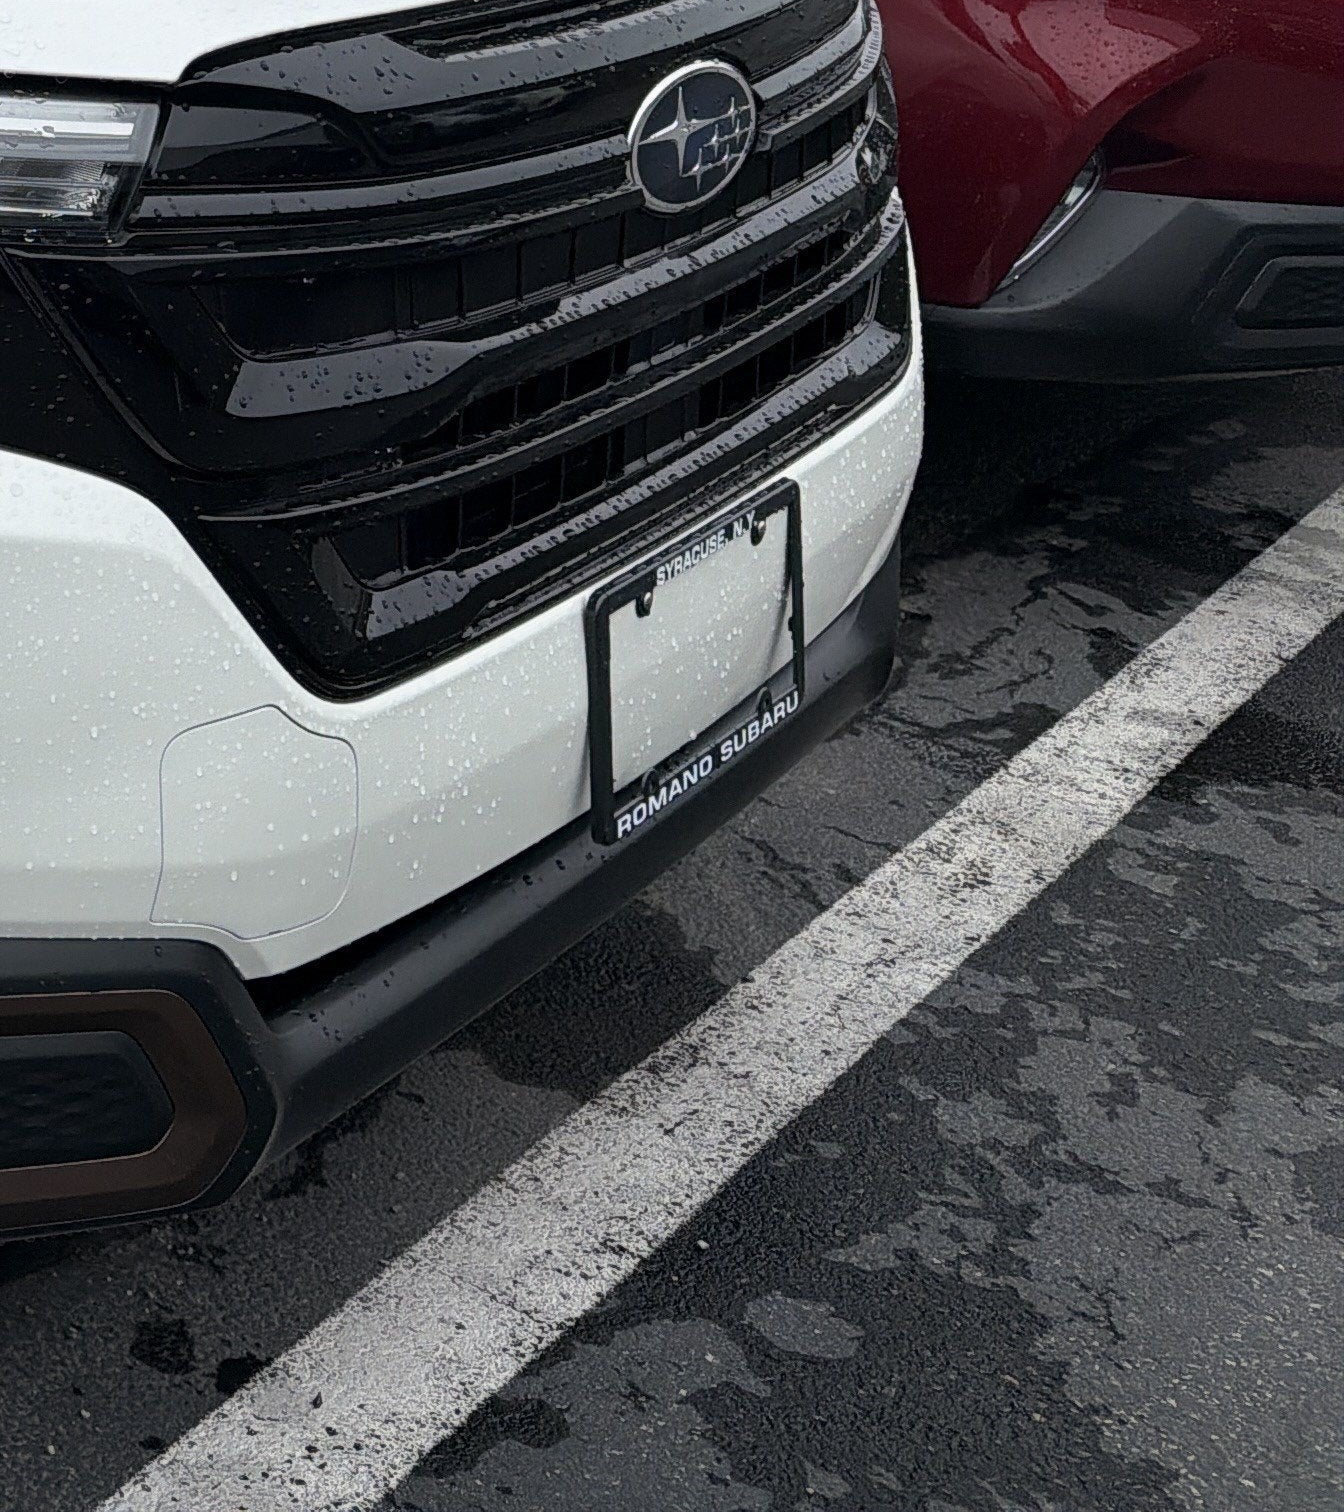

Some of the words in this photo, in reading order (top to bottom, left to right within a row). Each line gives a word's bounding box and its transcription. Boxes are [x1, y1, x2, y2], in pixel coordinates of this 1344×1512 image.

[656, 528, 729, 586] SYRACUSE,
[616, 755, 713, 839] ROMANO
[720, 690, 799, 762] SUBARU
